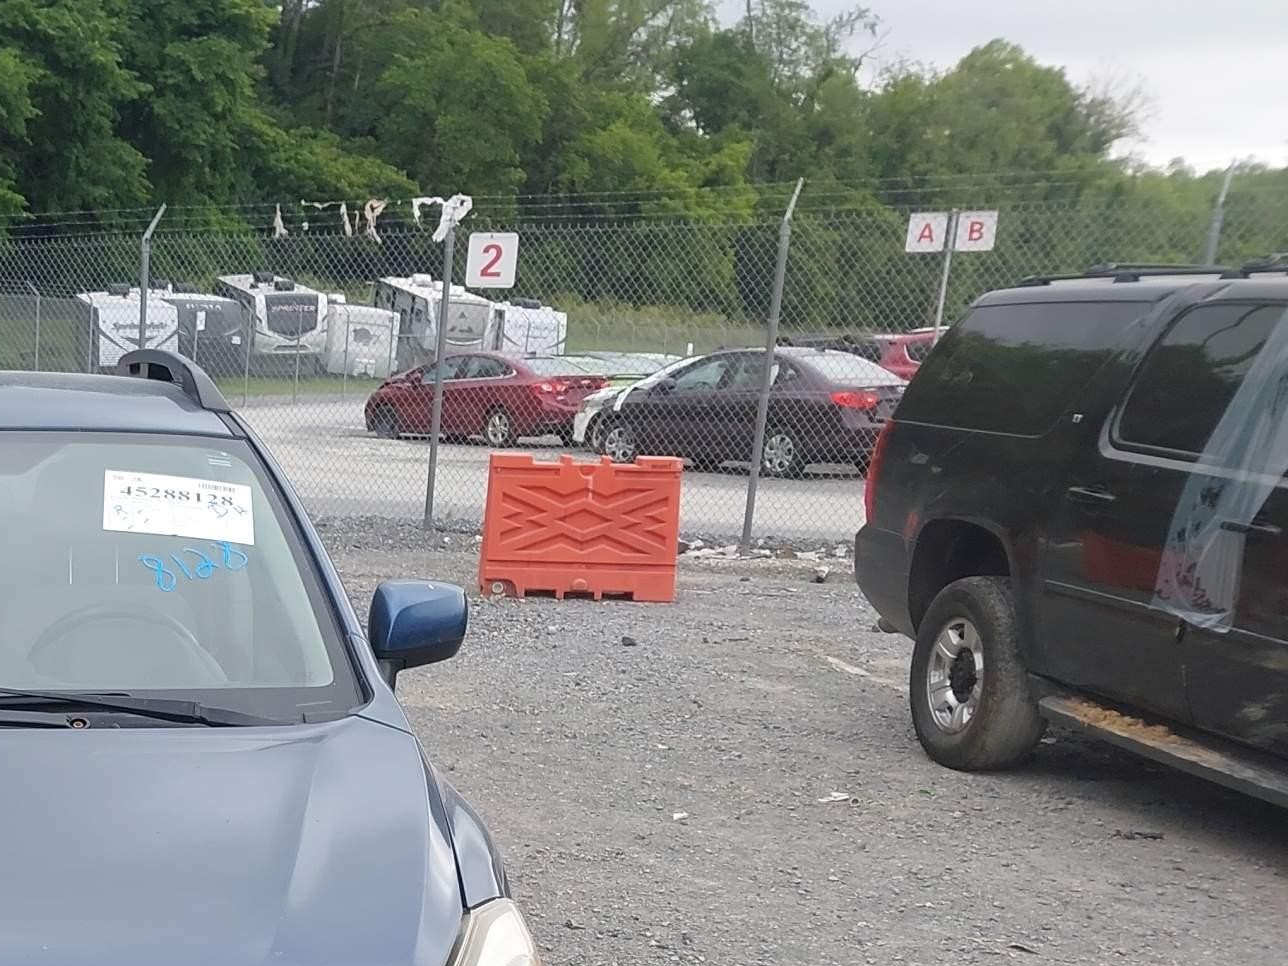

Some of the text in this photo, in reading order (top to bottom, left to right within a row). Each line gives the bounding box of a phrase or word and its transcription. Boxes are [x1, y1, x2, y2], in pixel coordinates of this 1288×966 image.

[916, 223, 934, 243] A
[967, 221, 985, 242] B
[479, 243, 503, 277] 2
[120, 485, 234, 506] 45288128
[137, 540, 249, 592] 8128
